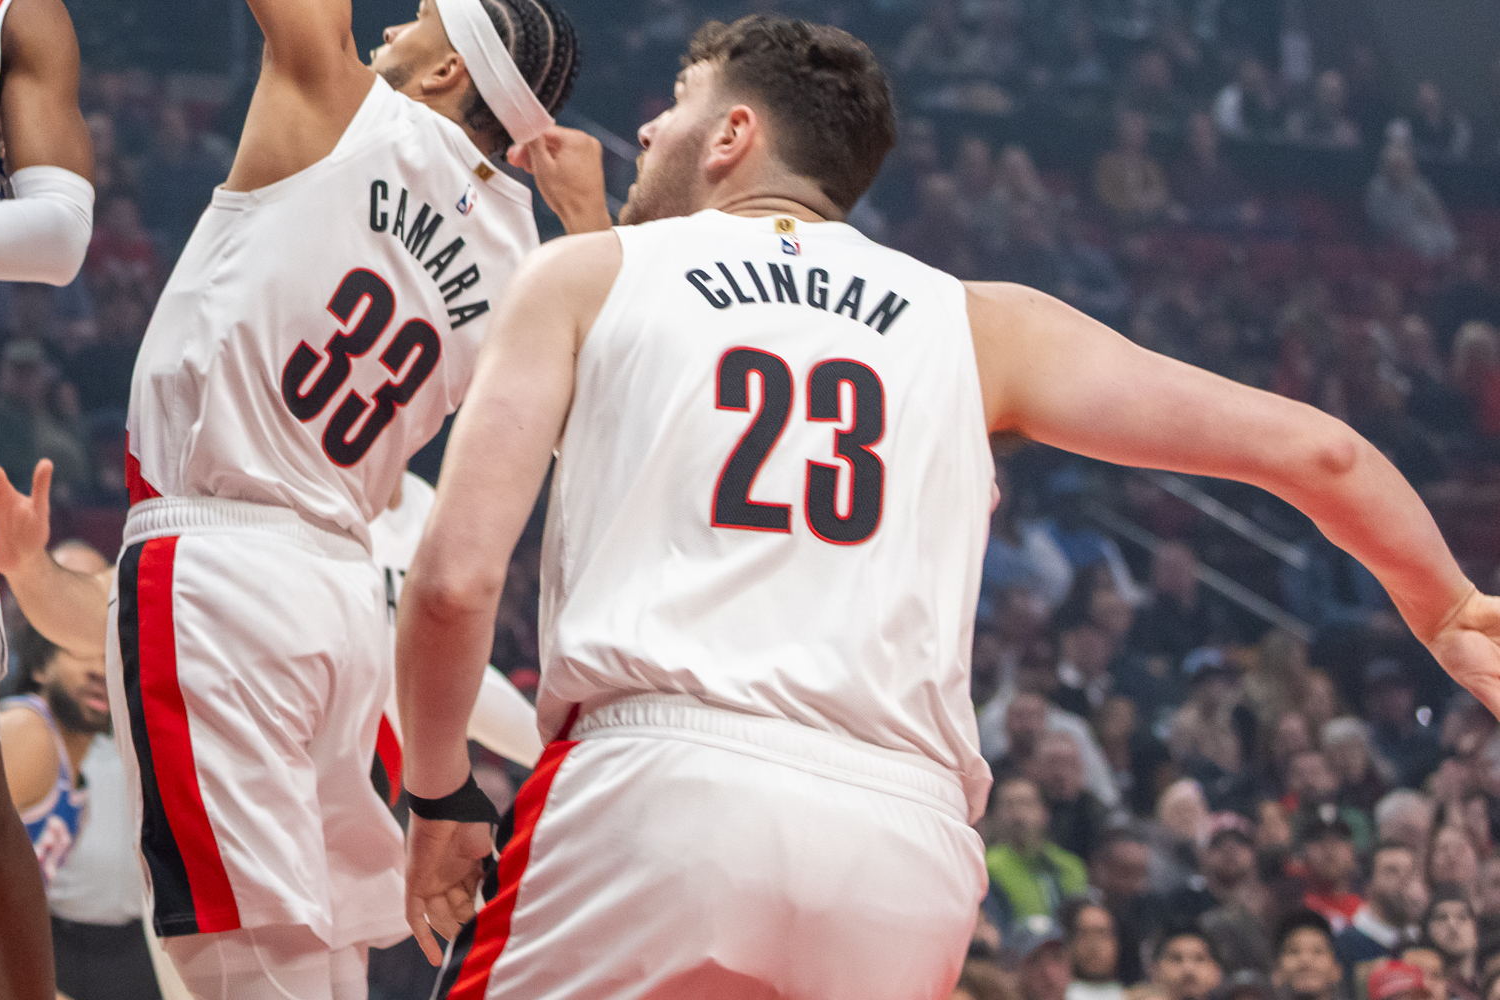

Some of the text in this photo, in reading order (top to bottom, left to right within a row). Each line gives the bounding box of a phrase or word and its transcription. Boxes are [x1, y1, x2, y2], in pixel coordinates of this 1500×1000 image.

[369, 179, 490, 330] CAMARA
[685, 260, 911, 337] CLINGAN
[281, 266, 442, 468] 33
[711, 346, 886, 546] 23
